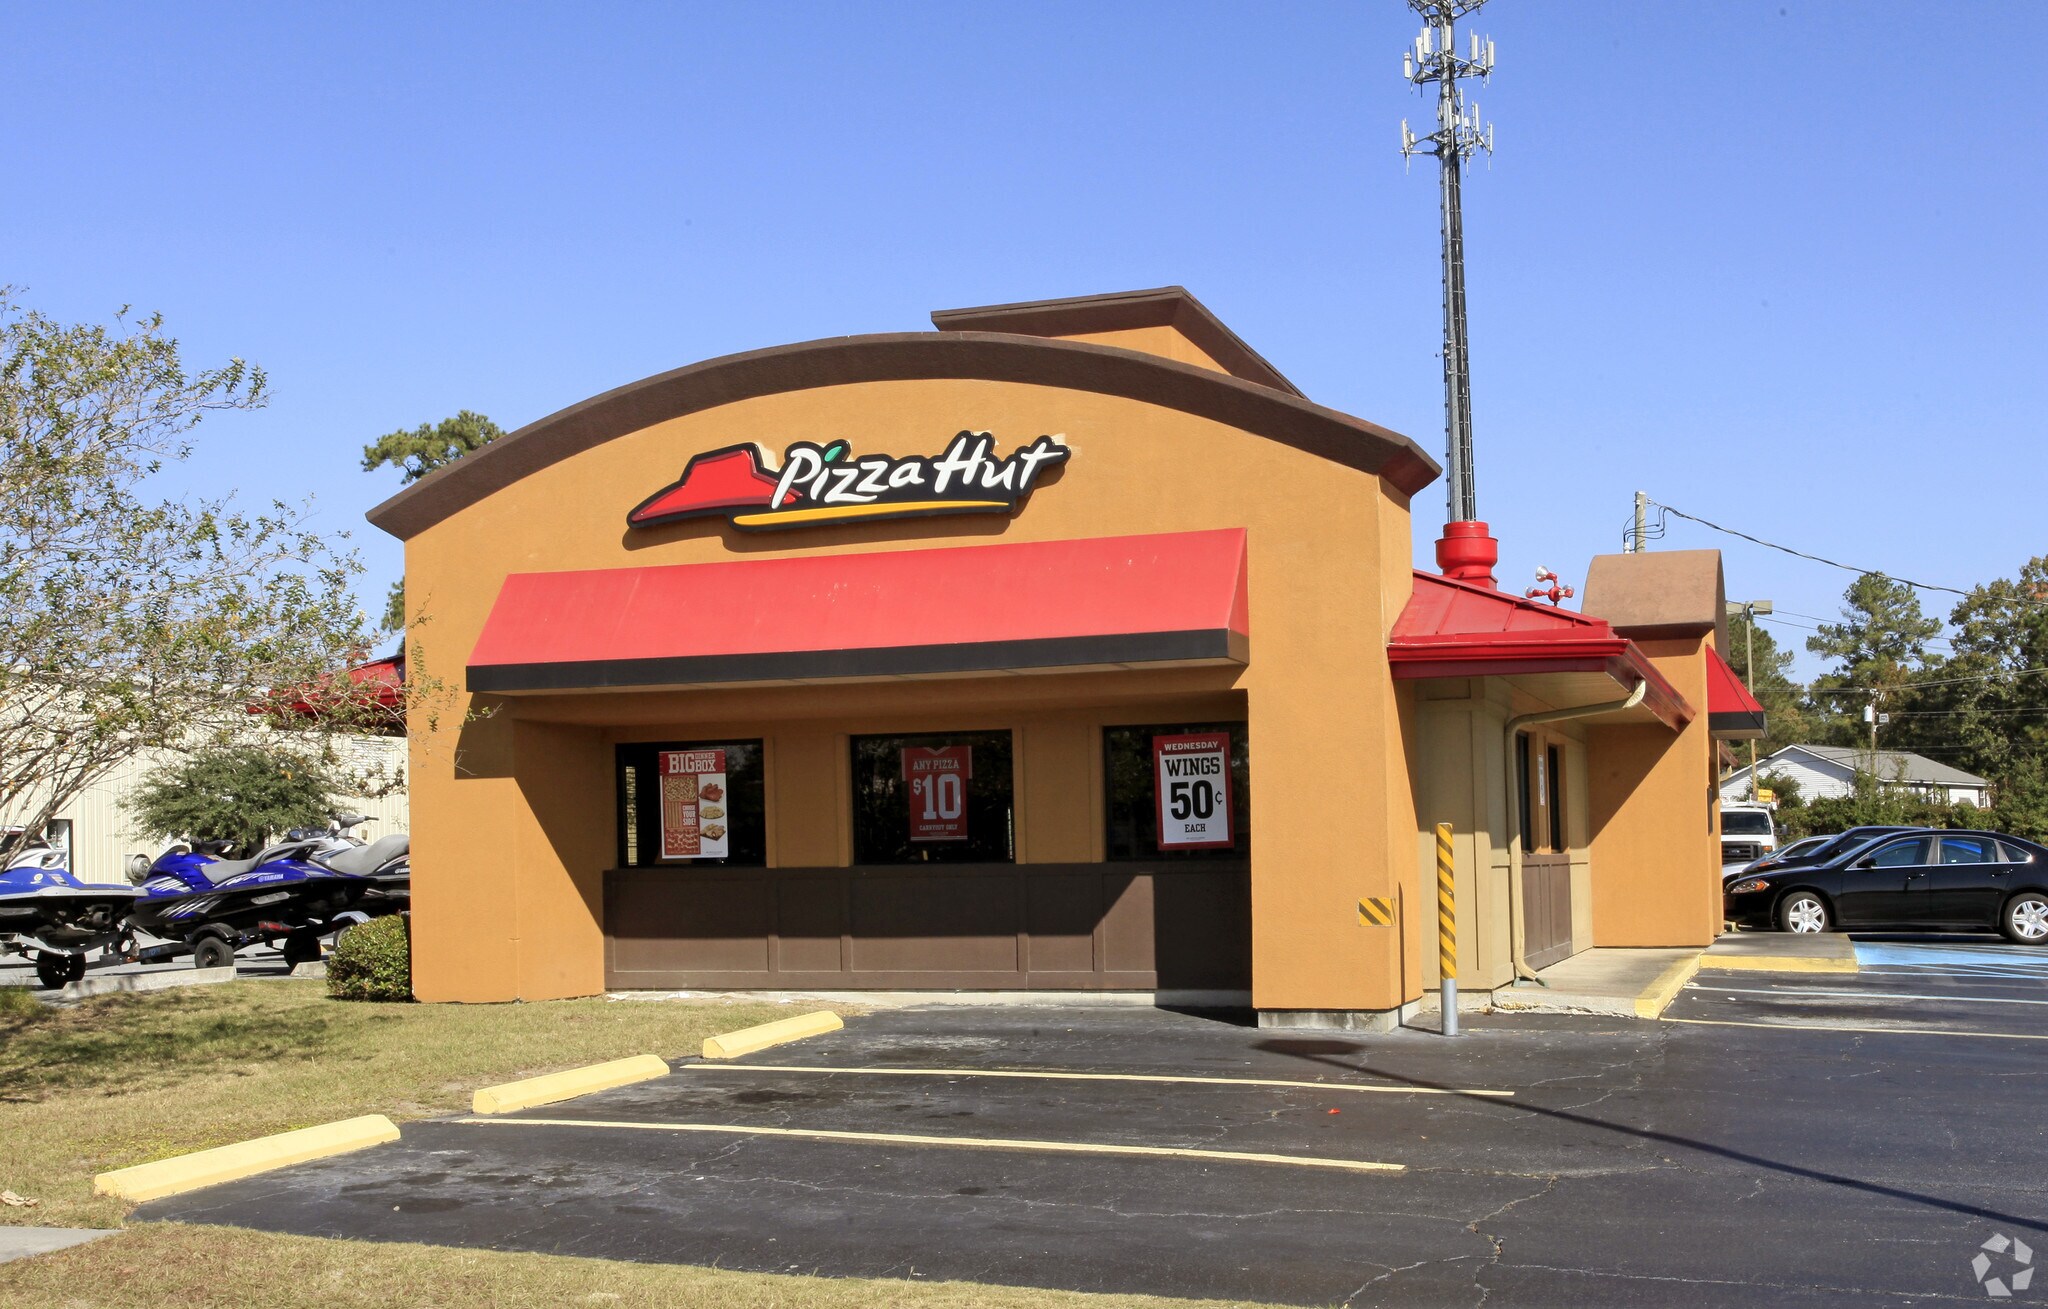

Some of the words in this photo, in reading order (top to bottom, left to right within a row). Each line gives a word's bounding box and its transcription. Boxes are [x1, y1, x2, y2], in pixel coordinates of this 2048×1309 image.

[771, 445, 925, 509] Pizza
[933, 437, 1064, 493] Hut
[1164, 741, 1219, 751] WEDNESDAY
[668, 753, 695, 774] BIG
[695, 759, 716, 773] BOX
[913, 760, 932, 771] ANY
[933, 759, 960, 770] PIZZA
[1165, 757, 1221, 777] WINGS
[913, 773, 961, 820] $10
[1184, 823, 1206, 833] EACH
